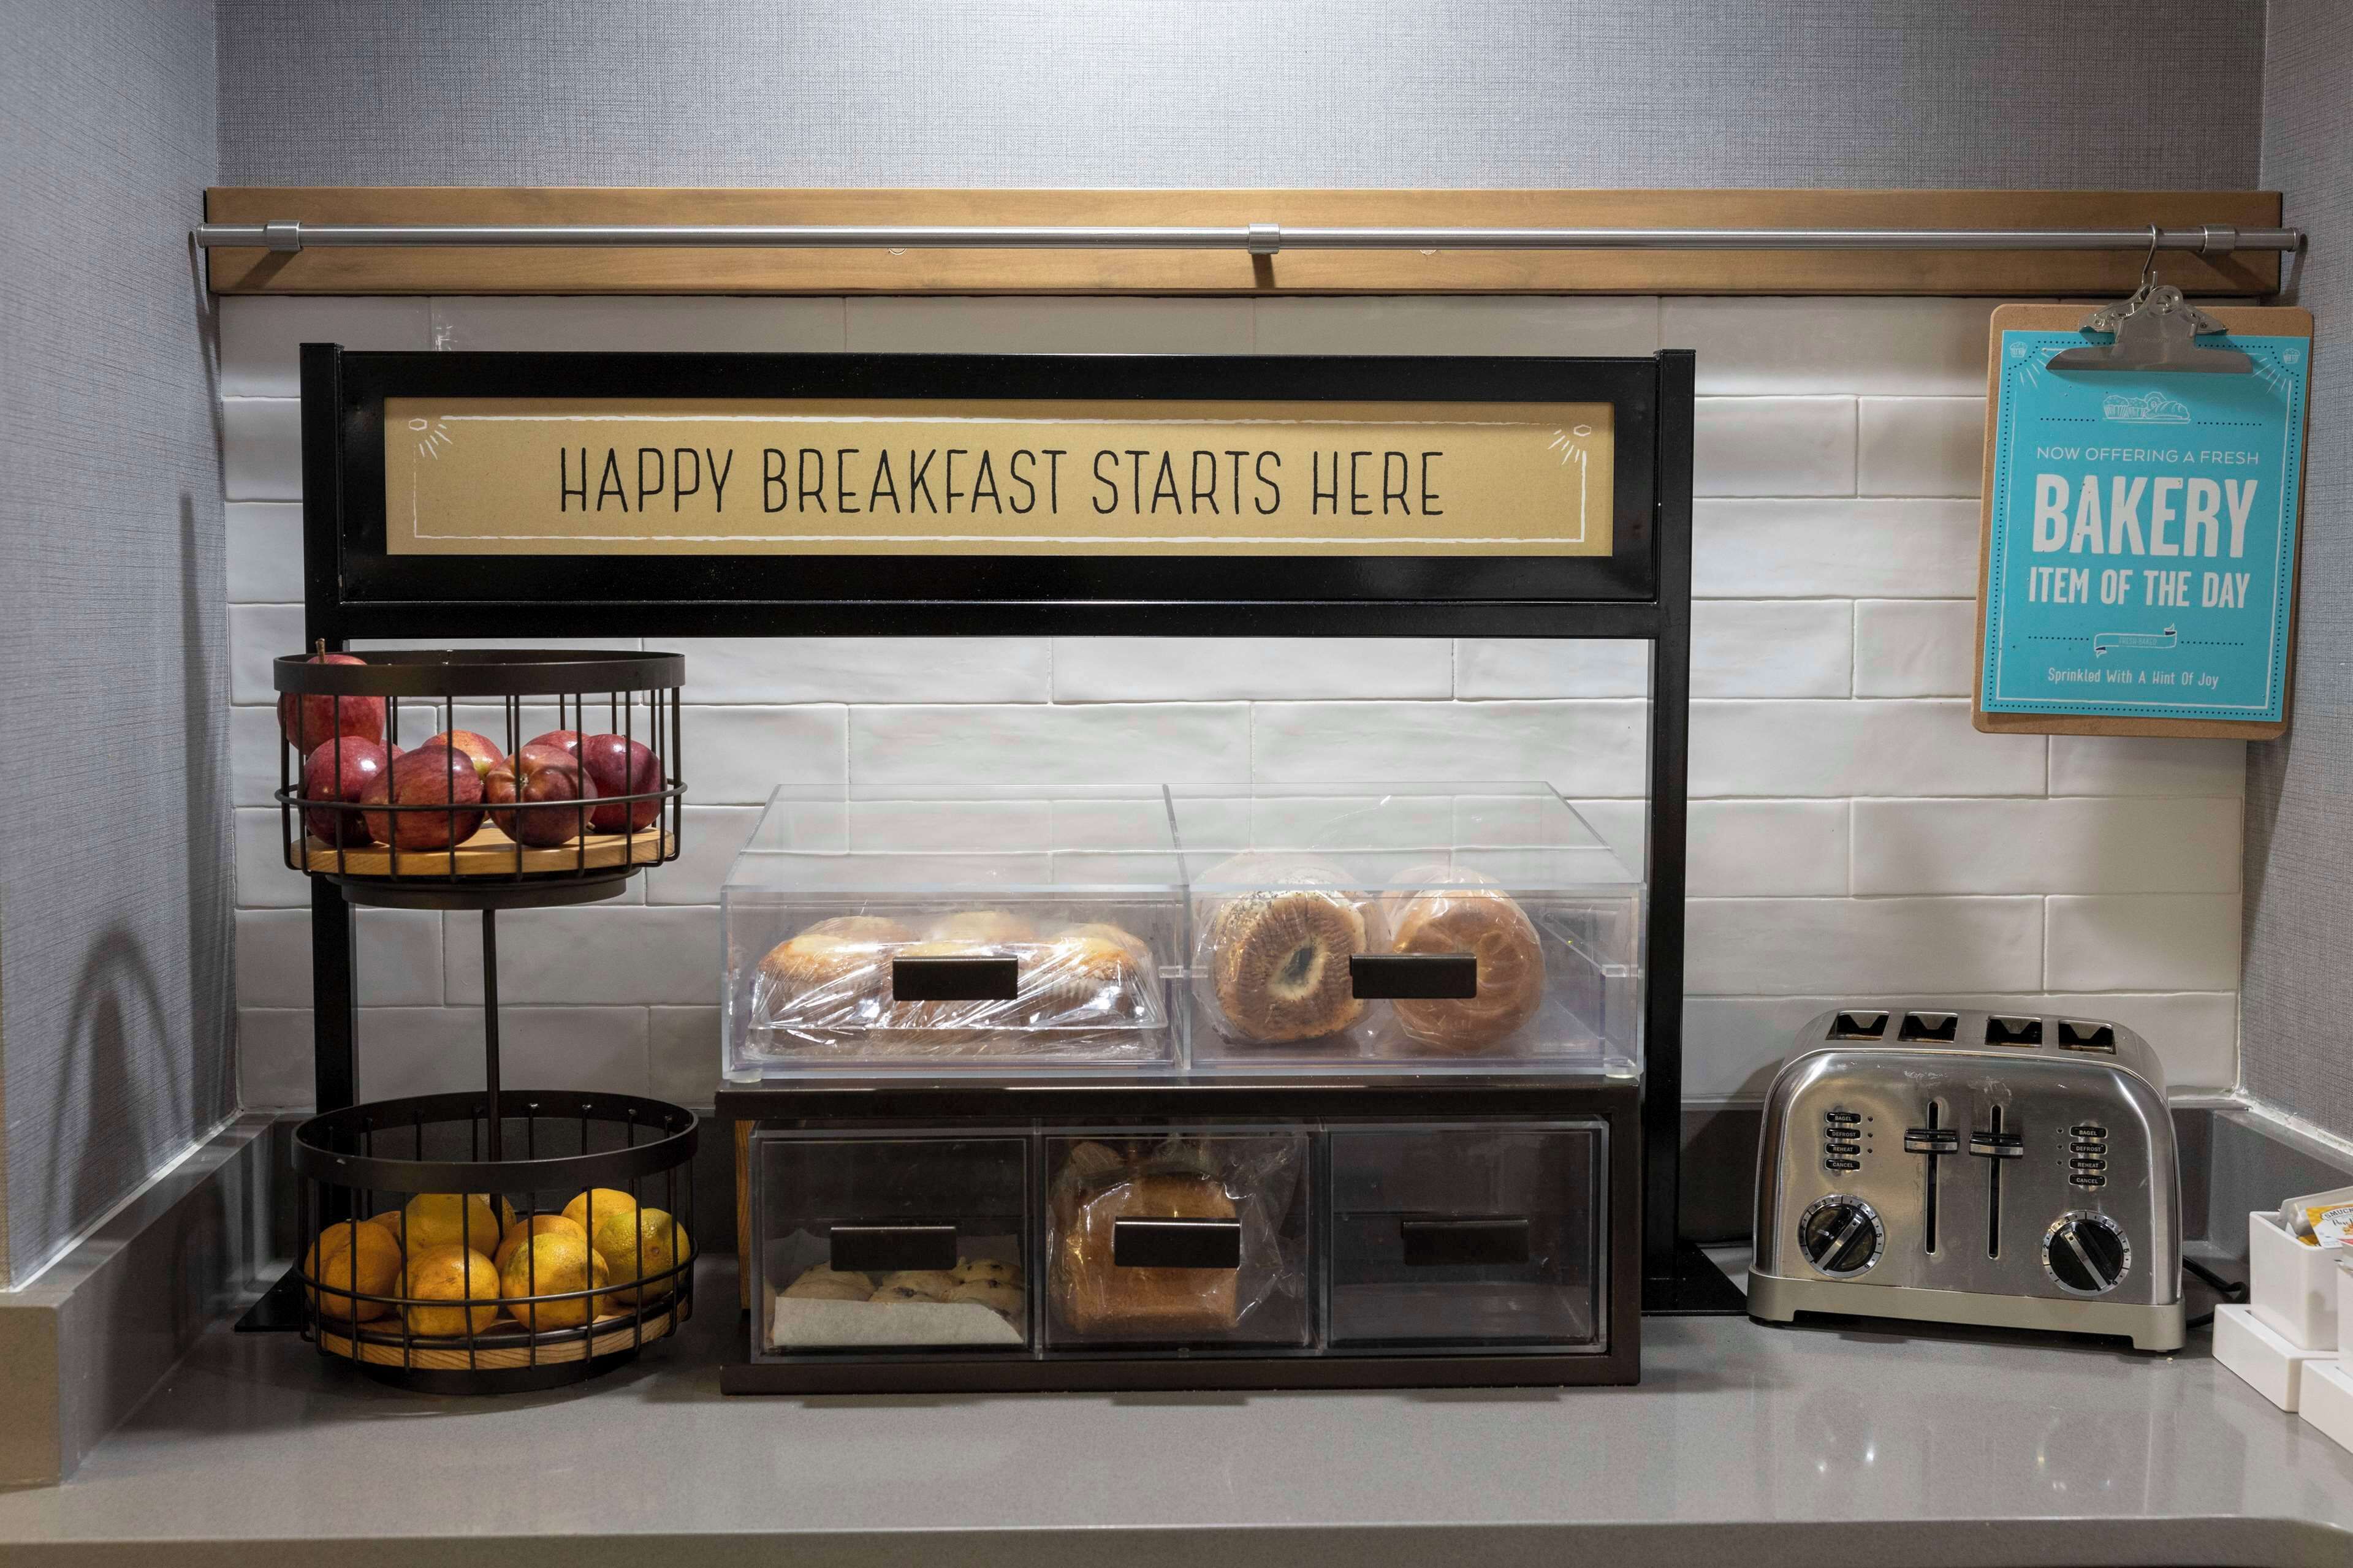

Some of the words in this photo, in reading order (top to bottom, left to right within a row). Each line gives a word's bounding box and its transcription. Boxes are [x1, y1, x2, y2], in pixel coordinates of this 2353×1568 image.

[2037, 446, 2080, 460] NOW
[2085, 447, 2178, 463] OFFERING
[2183, 451, 2195, 463] A
[2200, 451, 2259, 464] FRESH
[560, 447, 732, 512] HAPPY
[763, 448, 1066, 514] BREAKFAST
[1092, 449, 1281, 515] STARTS
[1312, 451, 1444, 516] HERE
[2032, 474, 2258, 558] BAKERY
[2029, 567, 2089, 604] ITEM
[2100, 569, 2133, 605] OF
[2144, 570, 2192, 607] THE
[2202, 572, 2251, 608] DAY
[2048, 667, 2100, 684] Sprinkled
[2106, 670, 2132, 684] With
[2138, 673, 2145, 684] A
[2153, 671, 2176, 684] Hint
[2181, 672, 2194, 685] Of
[2198, 673, 2219, 689] Joy
